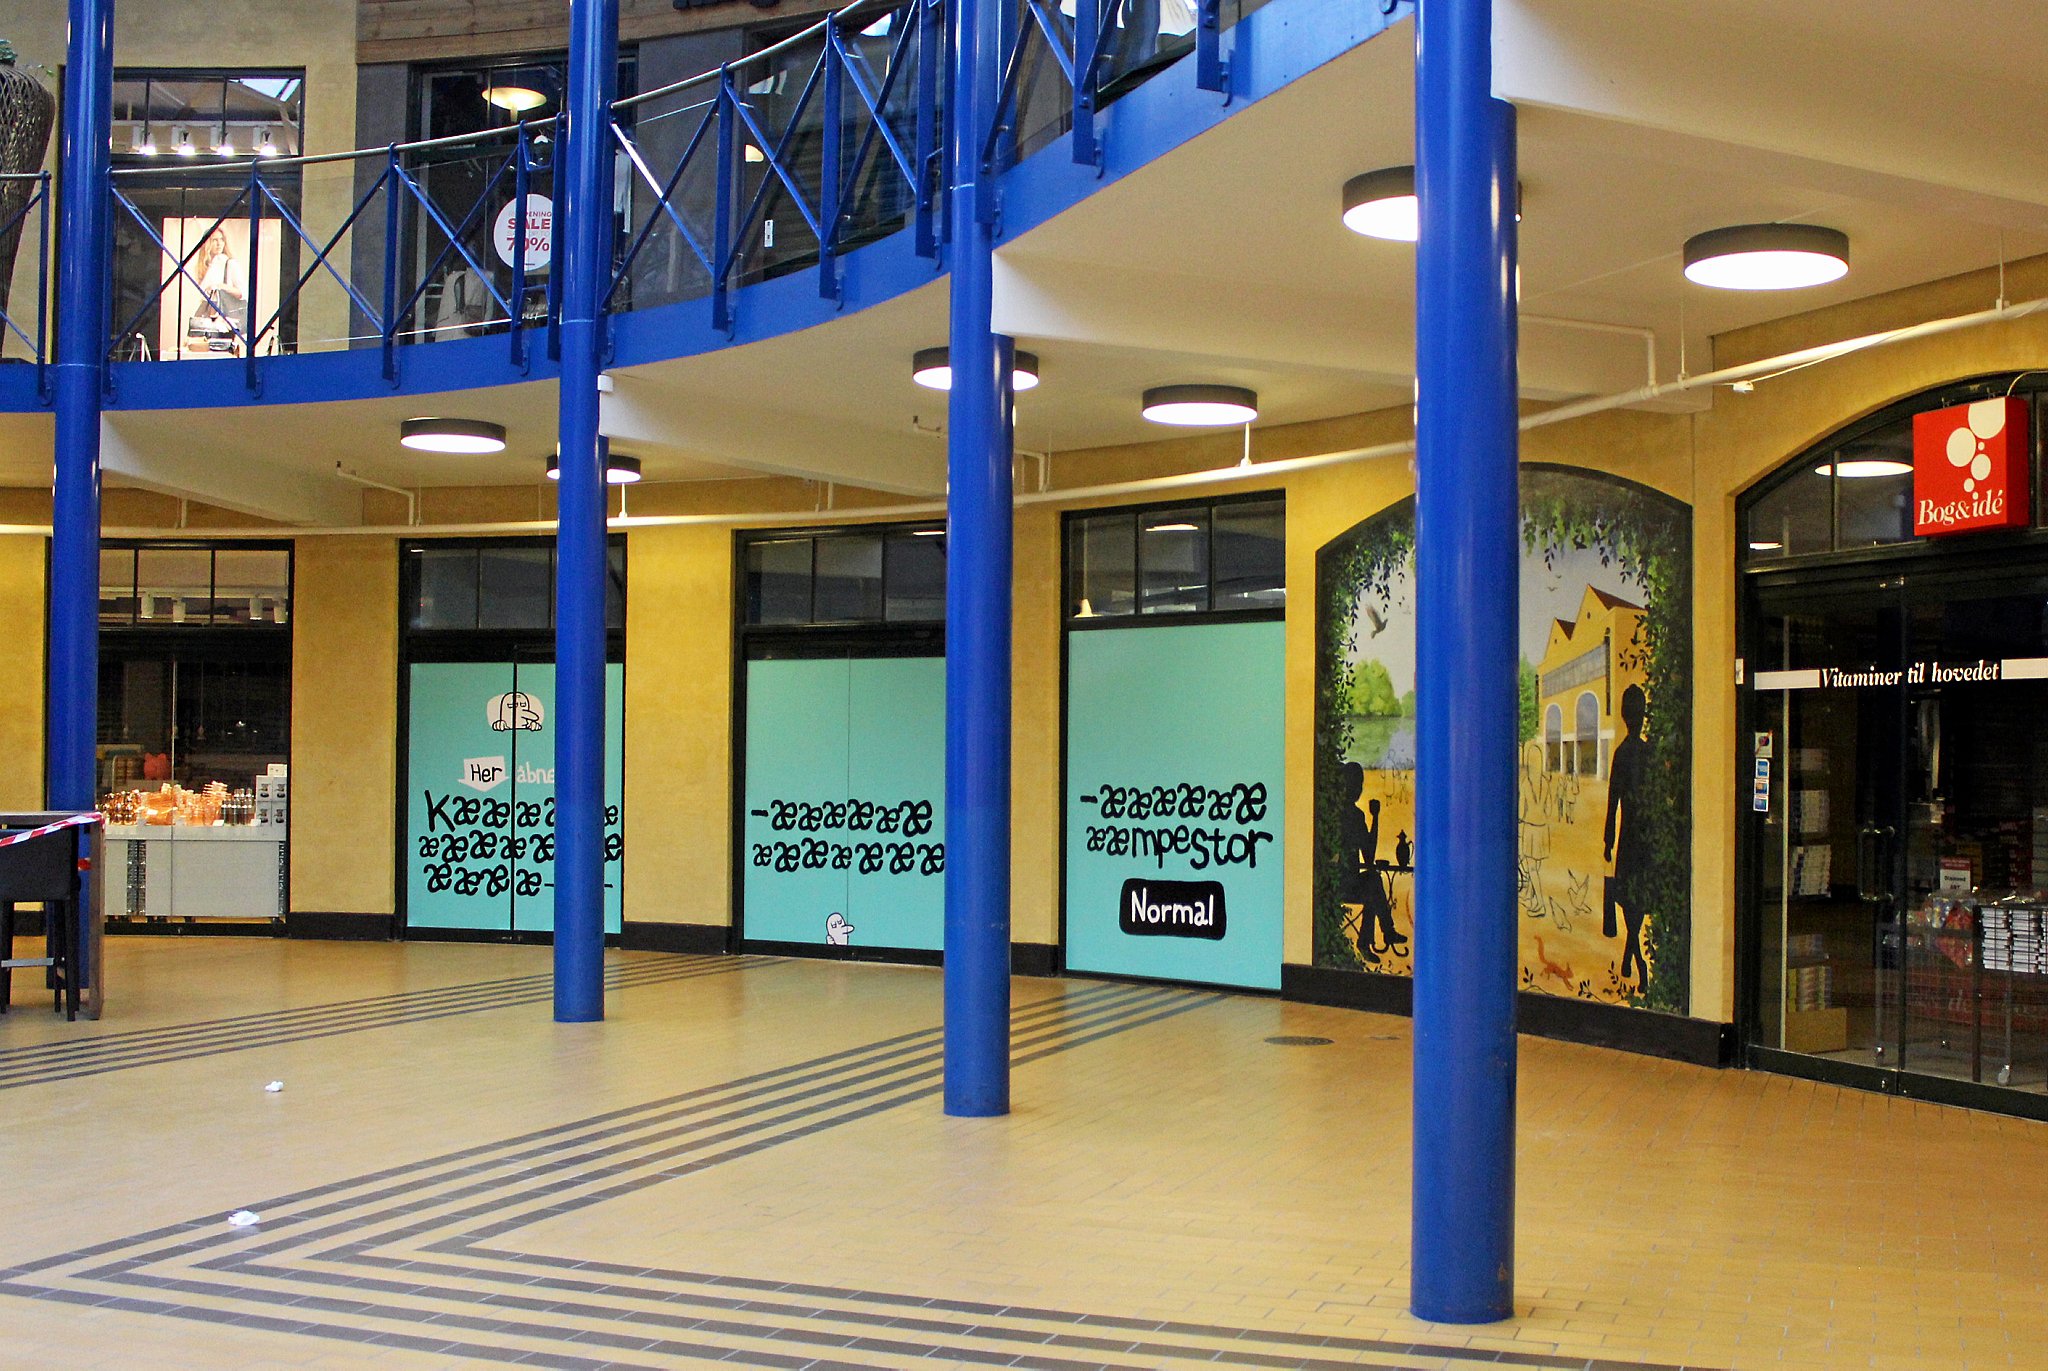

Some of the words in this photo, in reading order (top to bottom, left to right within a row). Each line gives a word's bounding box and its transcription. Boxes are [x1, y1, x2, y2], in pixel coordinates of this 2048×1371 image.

[1821, 667, 1903, 688] Vitaminer
[1907, 662, 1925, 684] til
[1931, 659, 2000, 682] hovedet
[470, 763, 502, 782] Her
[516, 761, 555, 784] åbne
[1131, 887, 1214, 926] Normal
